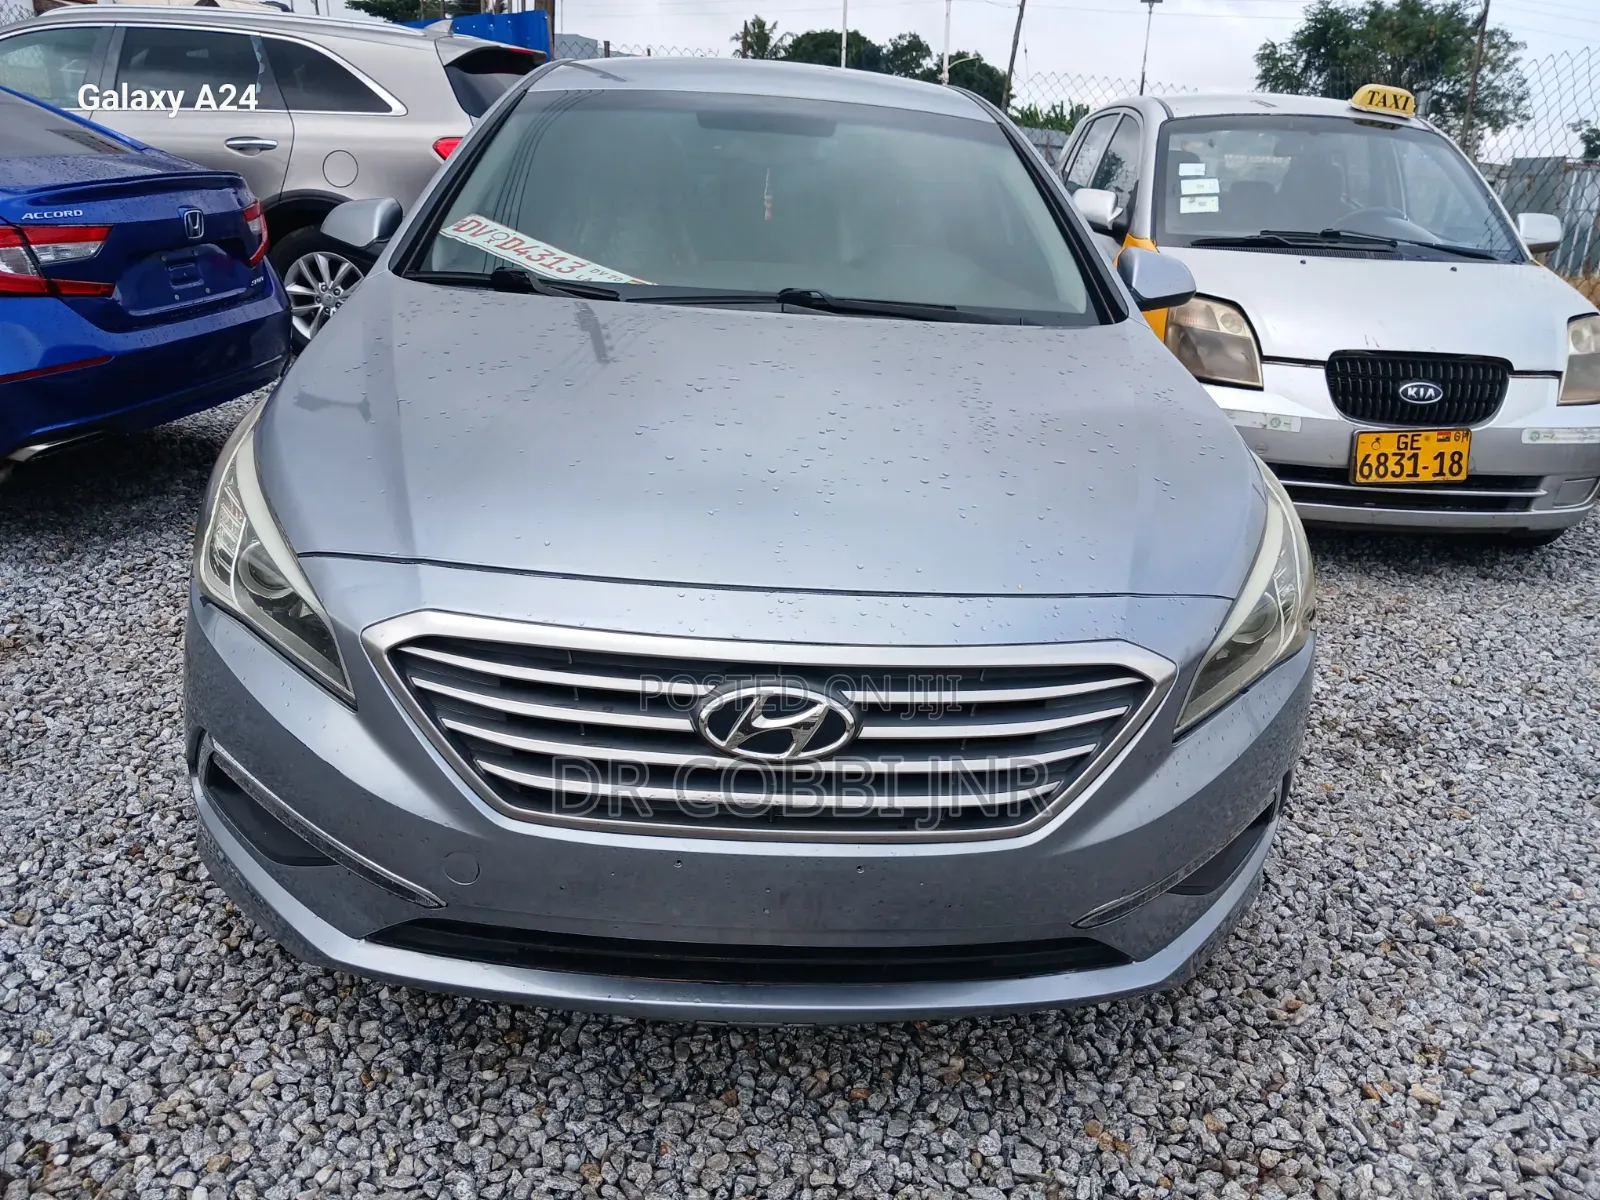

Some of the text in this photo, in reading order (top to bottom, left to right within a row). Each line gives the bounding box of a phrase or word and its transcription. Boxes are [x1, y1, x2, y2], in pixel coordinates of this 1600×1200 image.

[1367, 90, 1411, 110] TAXI
[21, 209, 84, 221] ACCORD
[452, 219, 492, 238] DV
[1407, 387, 1435, 399] KIA
[1396, 433, 1422, 450] GE
[1359, 451, 1464, 480] 6831-18
